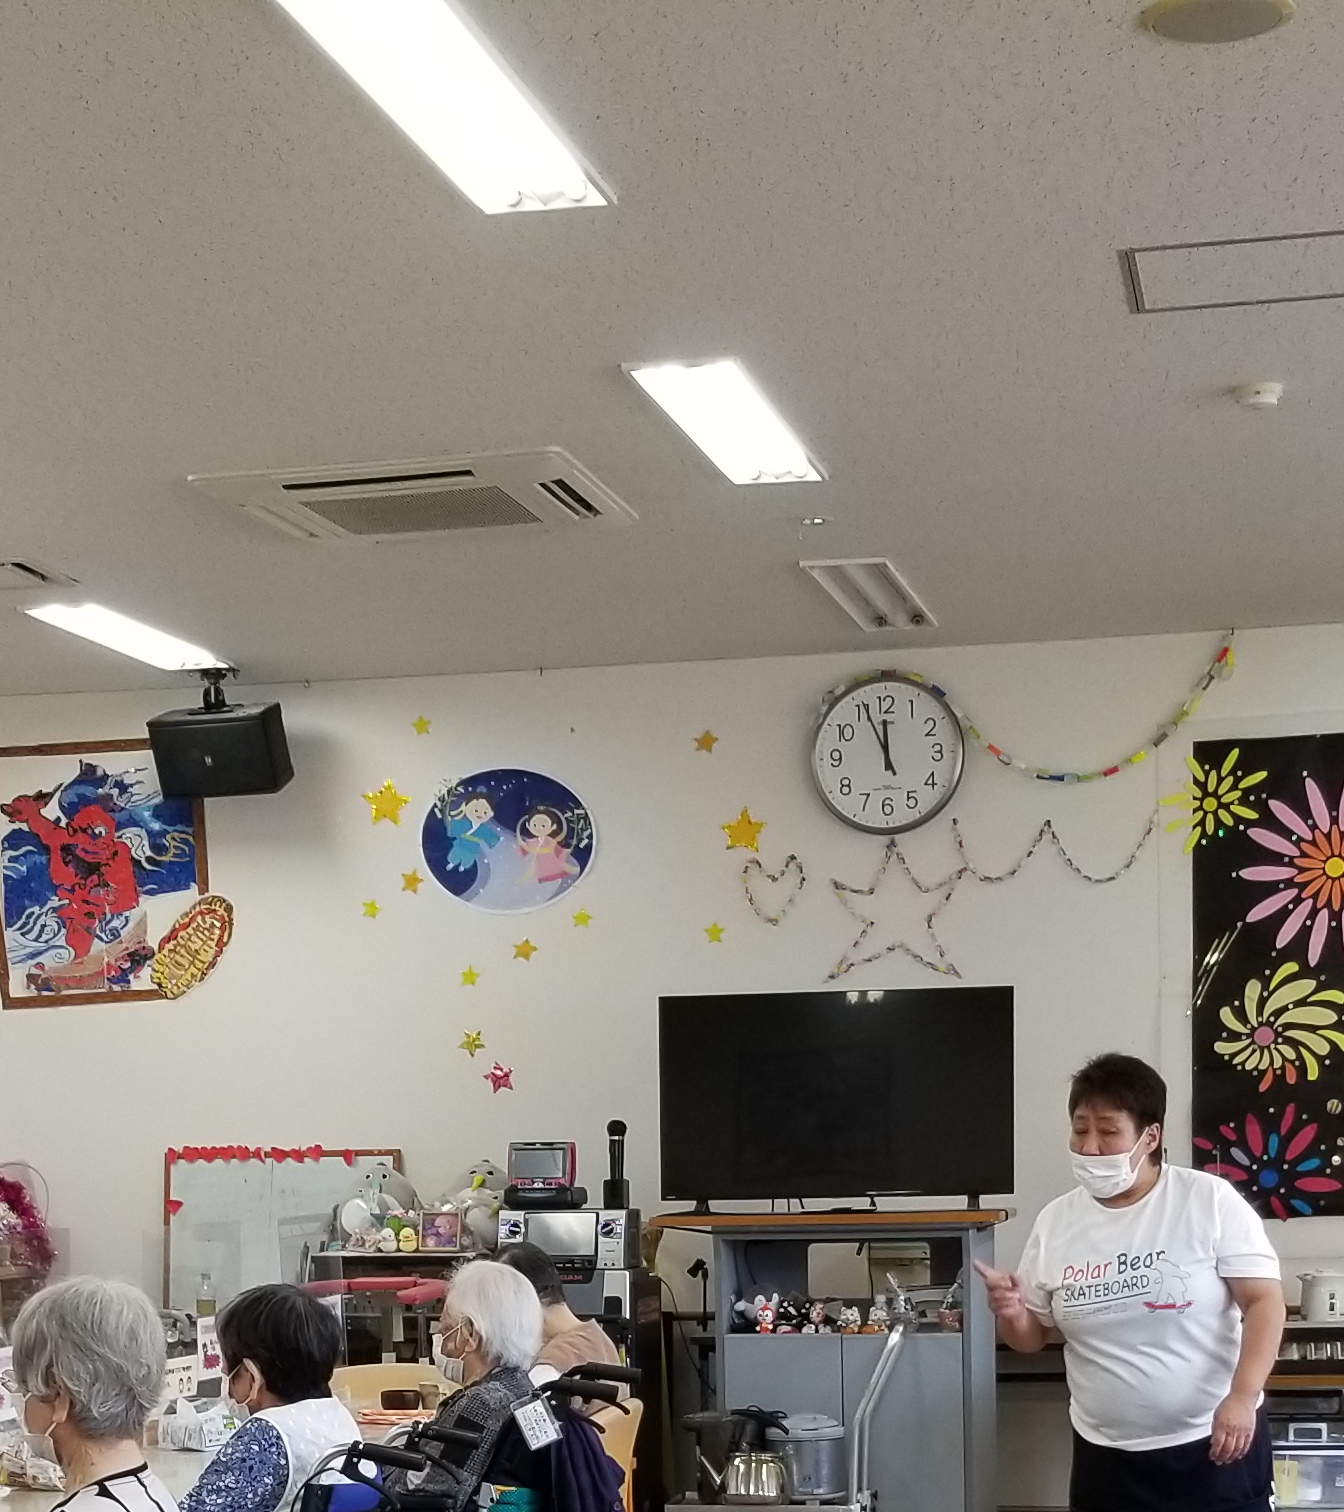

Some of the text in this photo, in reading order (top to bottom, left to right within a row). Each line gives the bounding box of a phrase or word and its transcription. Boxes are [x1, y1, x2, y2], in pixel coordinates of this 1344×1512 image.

[855, 703, 870, 722] 11
[876, 695, 895, 714] 12
[908, 700, 914, 719] 1
[836, 723, 855, 742] 10
[924, 717, 937, 737] 2
[830, 749, 843, 768] 9
[931, 743, 944, 762] 3
[840, 777, 852, 796] 8
[924, 771, 938, 791] 4
[858, 793, 871, 812] 7
[882, 797, 894, 816] 6
[906, 790, 919, 809] 5
[1061, 1249, 1166, 1288] Polar Bear
[1063, 1274, 1150, 1303] SKATEBOARD
